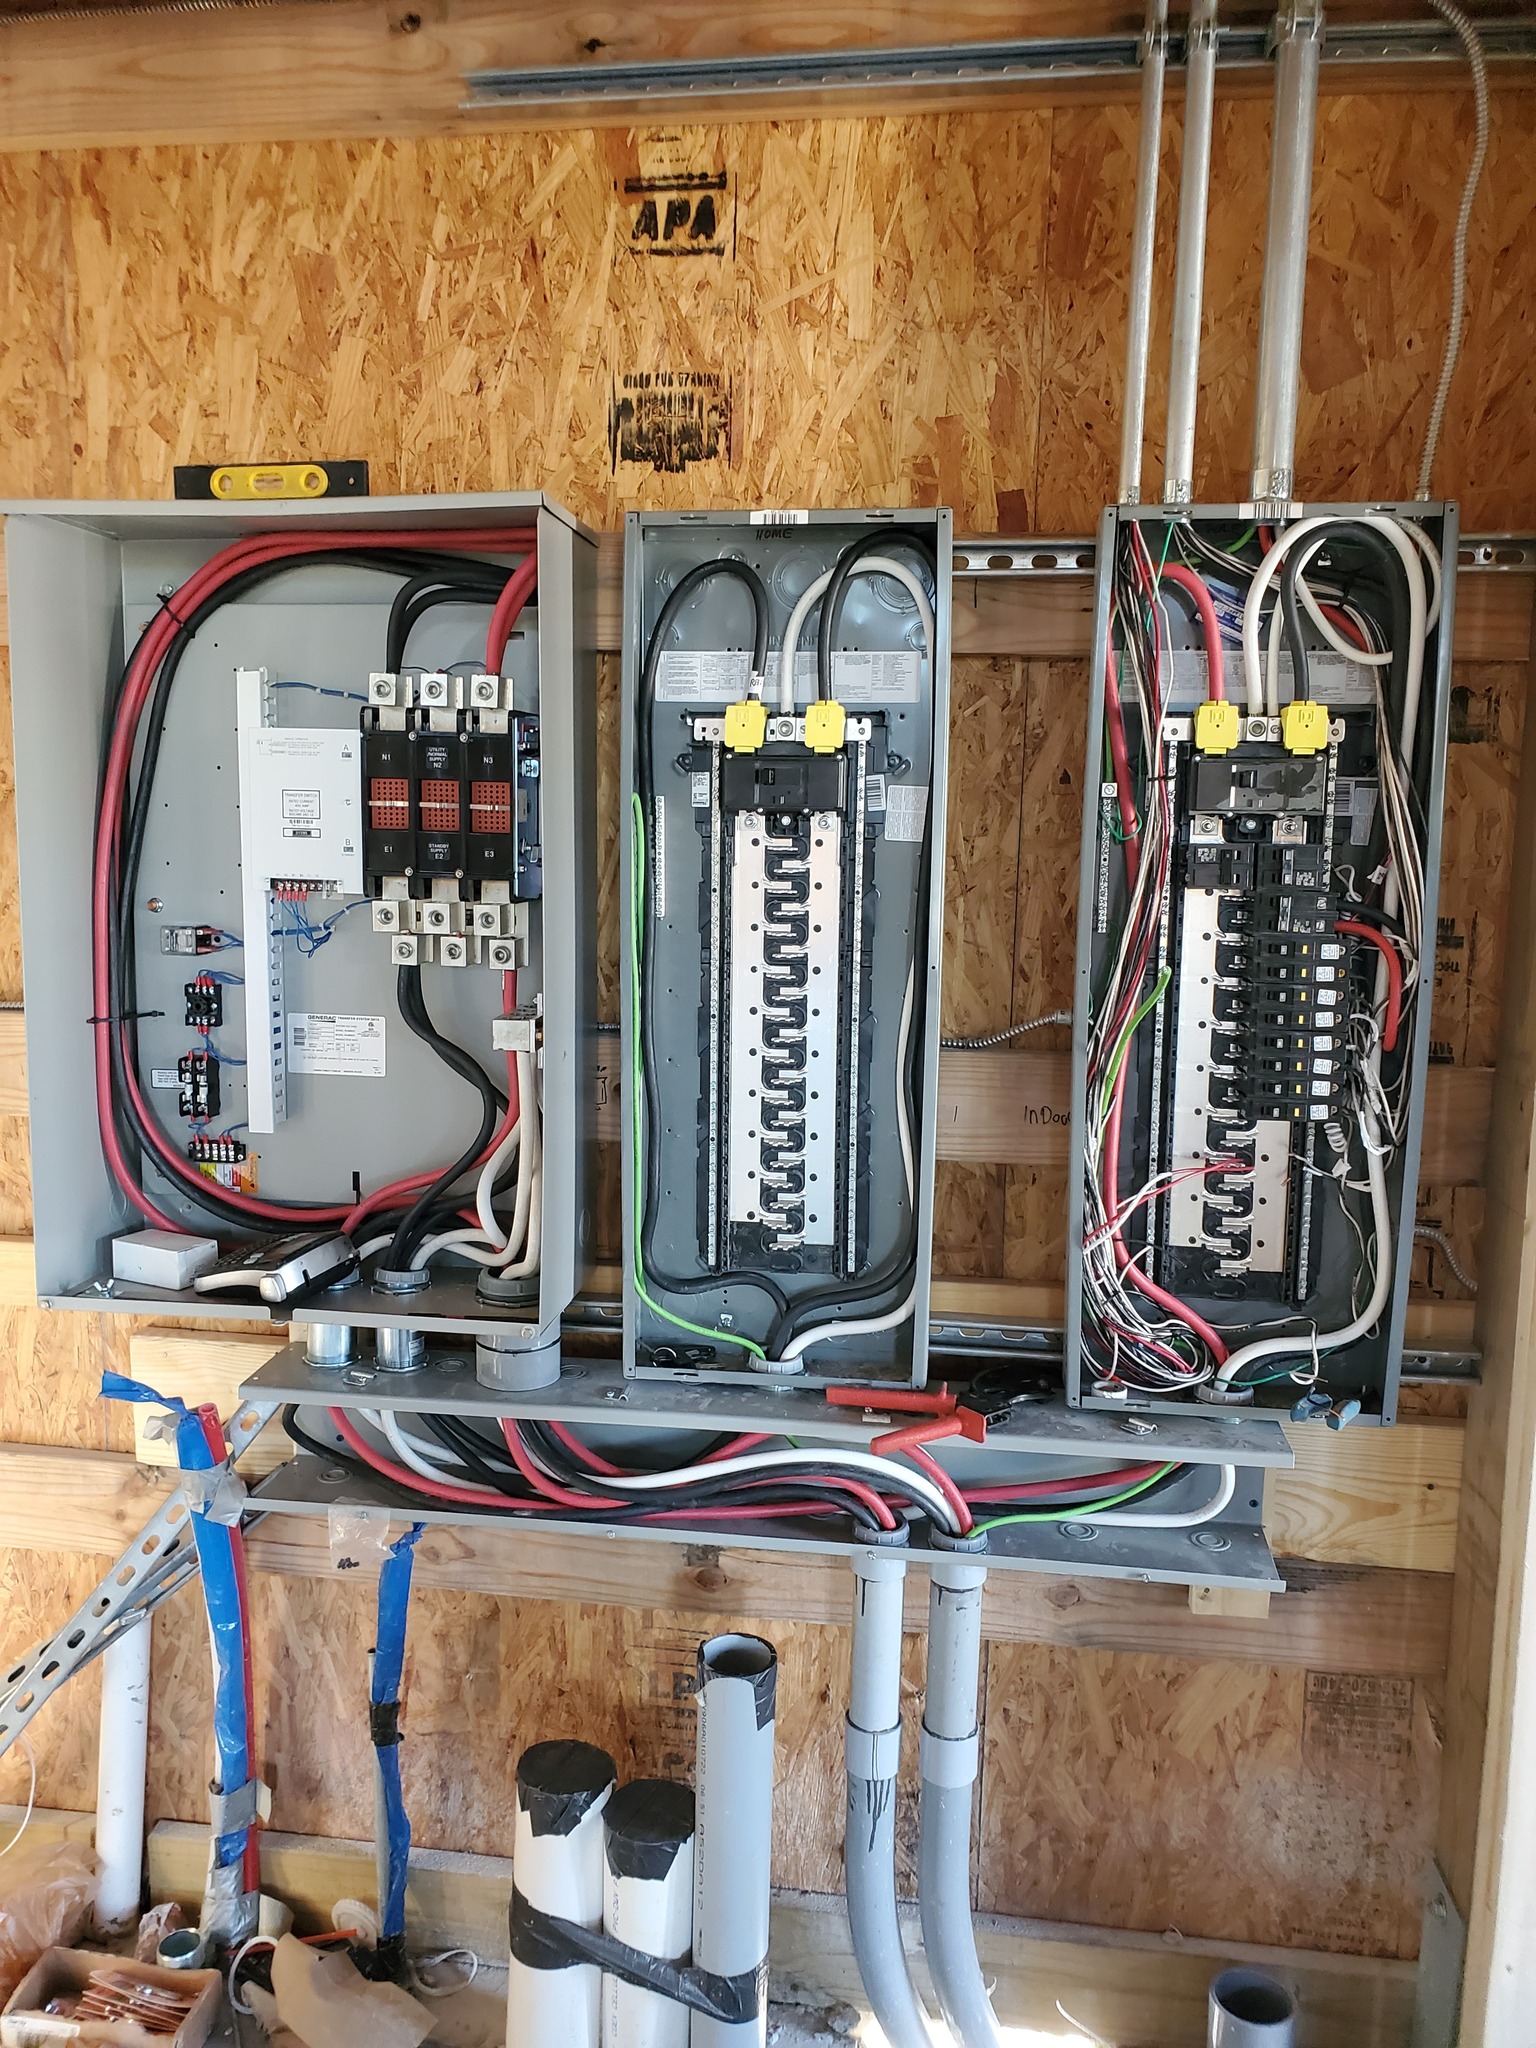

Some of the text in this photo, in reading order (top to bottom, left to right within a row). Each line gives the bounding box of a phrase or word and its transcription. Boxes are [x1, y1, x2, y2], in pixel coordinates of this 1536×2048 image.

[631, 195, 716, 241] APA
[755, 528, 794, 541] HOME
[381, 753, 391, 761] N1
[384, 845, 393, 853] E1
[484, 850, 495, 858] E3
